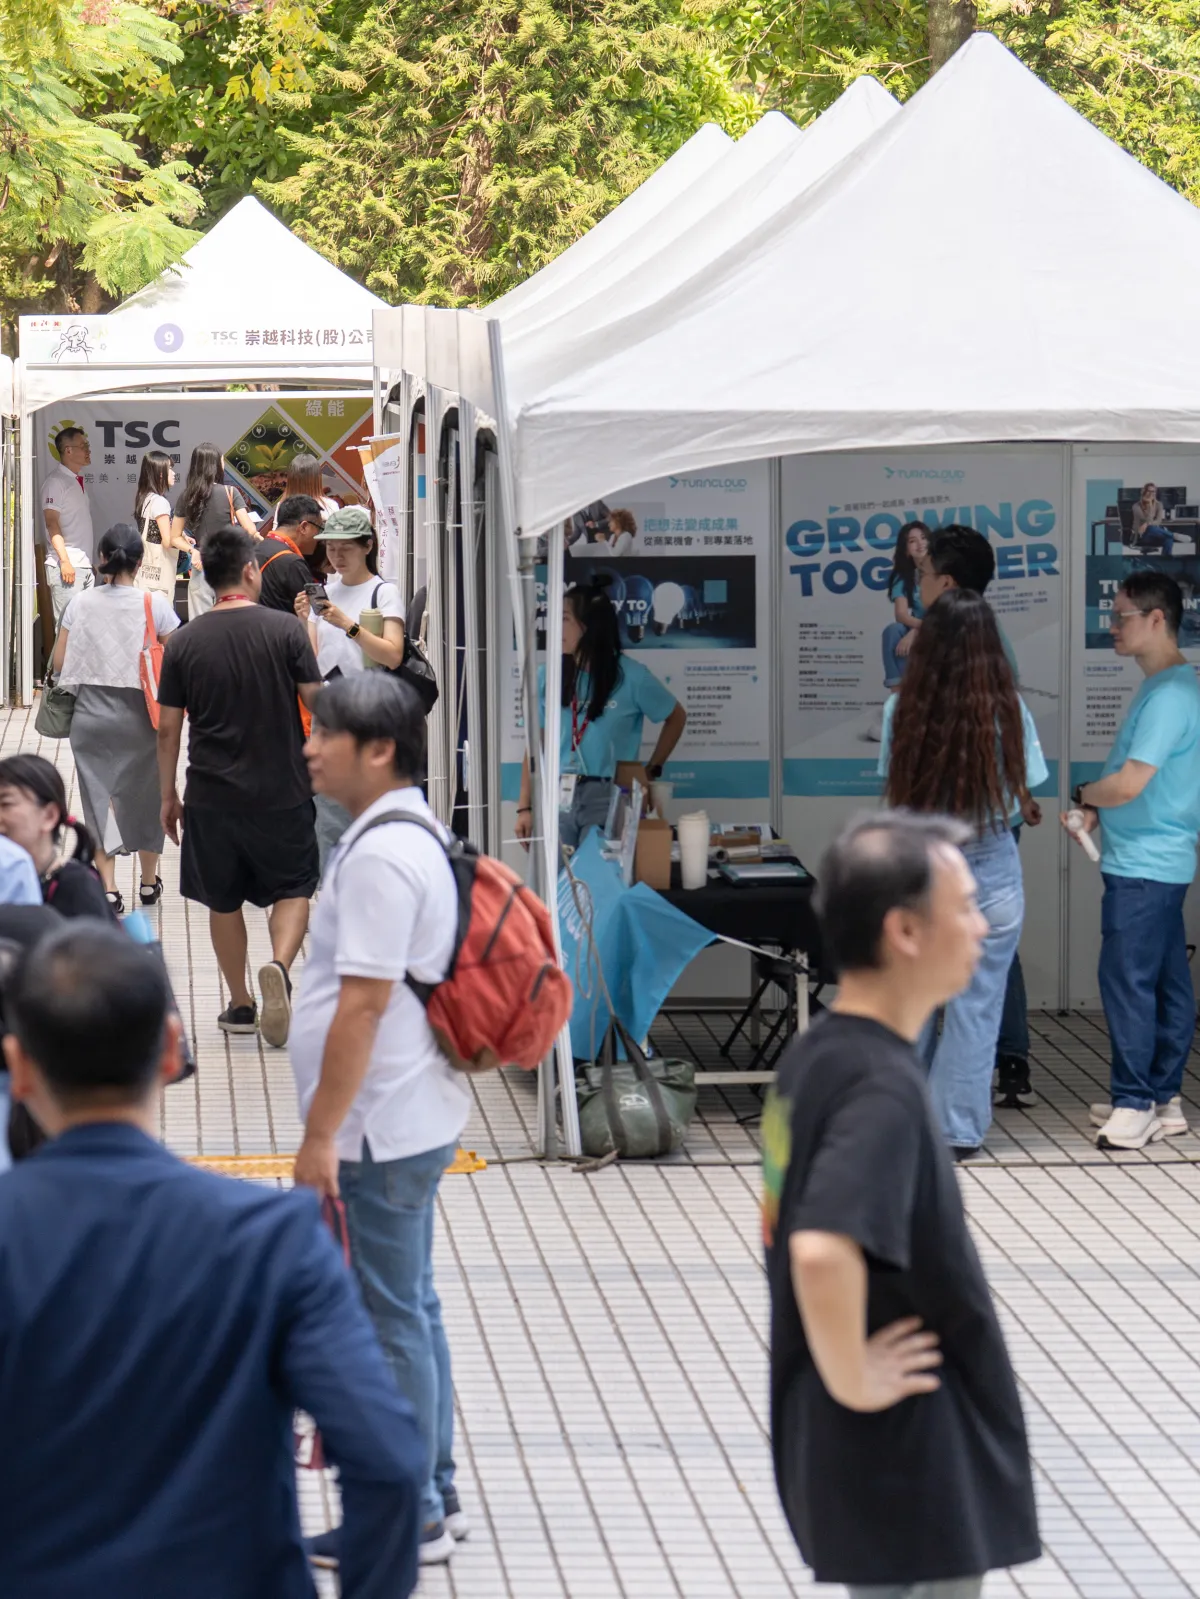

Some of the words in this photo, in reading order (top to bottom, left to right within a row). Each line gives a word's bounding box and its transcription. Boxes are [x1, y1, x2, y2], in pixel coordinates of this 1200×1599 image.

[164, 331, 175, 347] 9
[211, 331, 238, 340] TSC
[305, 400, 345, 417] 綠能
[95, 420, 181, 449] TSC
[680, 478, 747, 488] TURNCLOUD
[786, 499, 1056, 557] GROWING
[790, 543, 1060, 597] TOGER
[627, 600, 647, 610] TO
